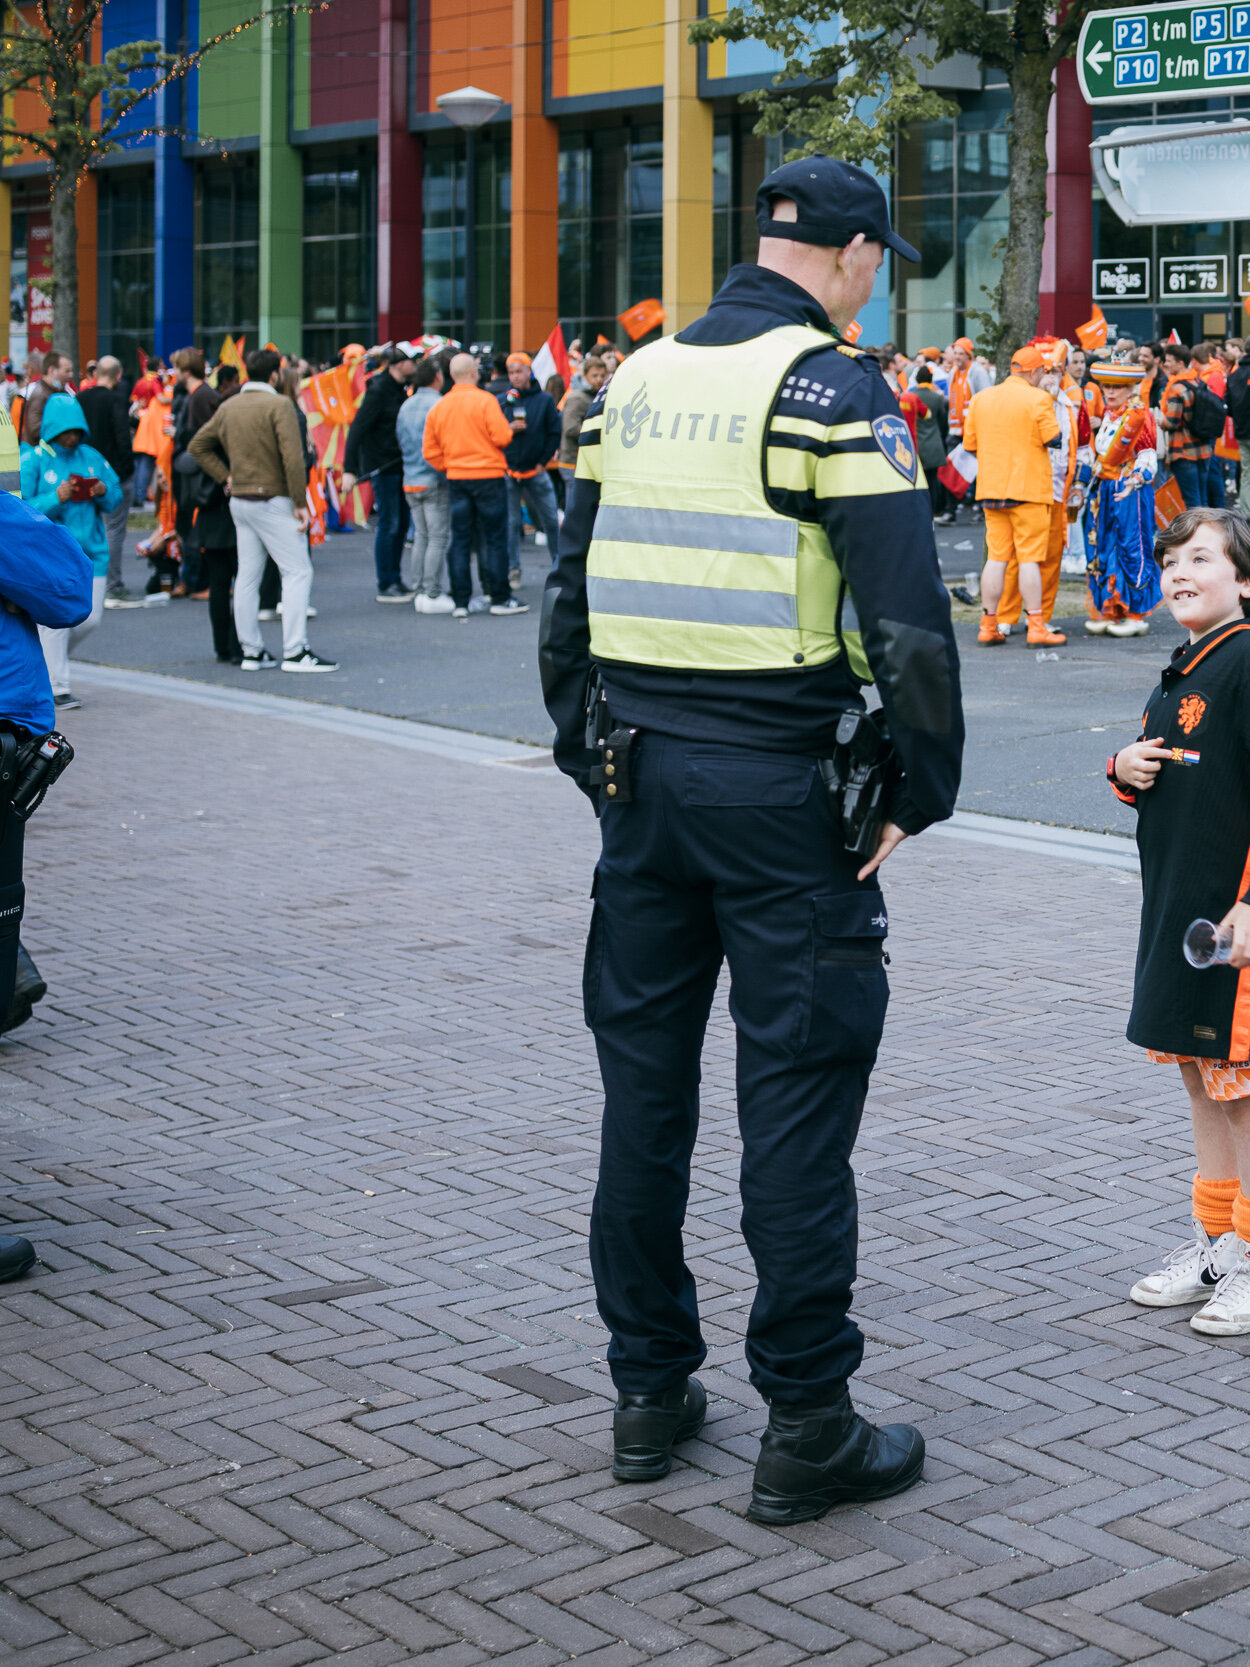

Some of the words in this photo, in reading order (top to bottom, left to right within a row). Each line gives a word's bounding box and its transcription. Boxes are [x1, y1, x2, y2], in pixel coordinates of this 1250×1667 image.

[1152, 19, 1187, 41] t/m
[1236, 11, 1248, 33] P
[1118, 58, 1154, 82] P10
[1165, 55, 1199, 79] t/m
[1209, 50, 1246, 73] P17
[1100, 270, 1142, 294] Regus
[604, 400, 747, 449] POLITIE
[1213, 1060, 1250, 1070] POCKIES
